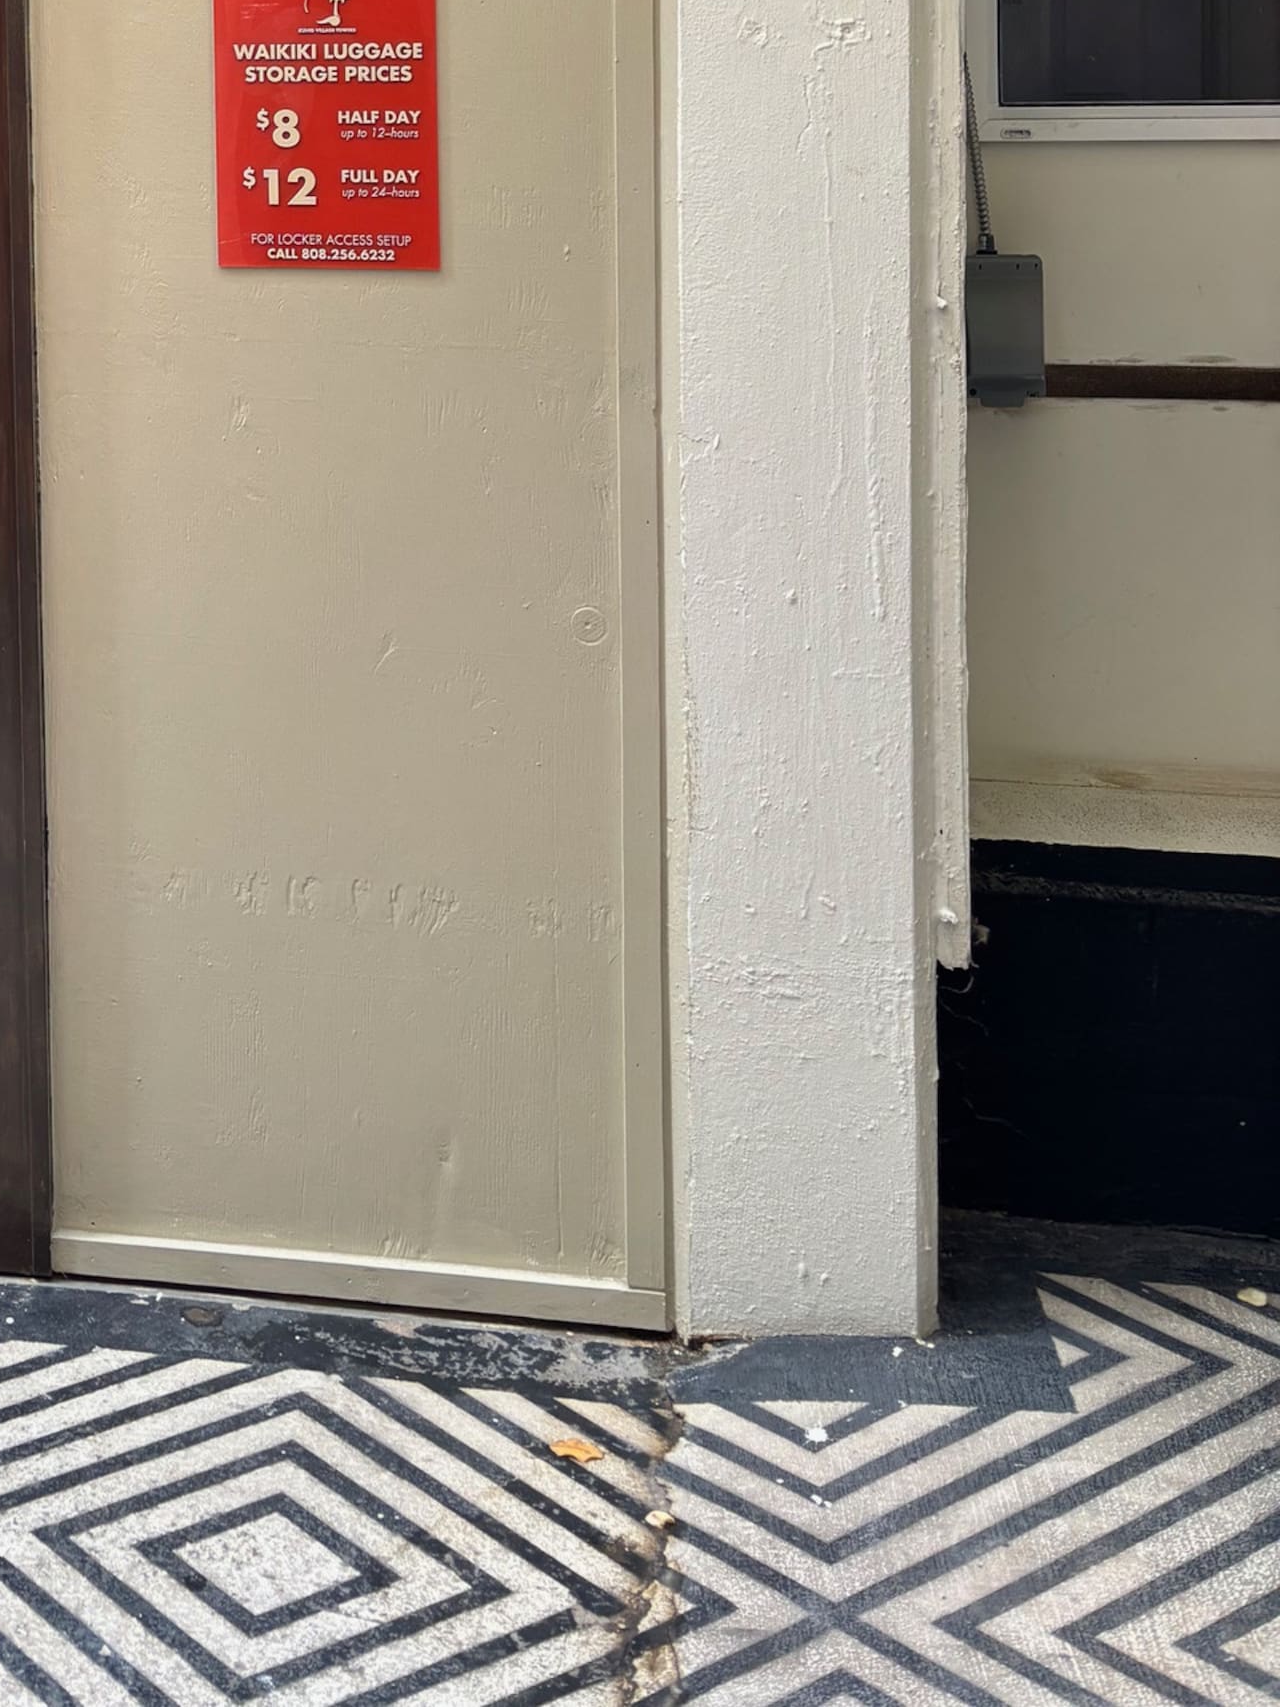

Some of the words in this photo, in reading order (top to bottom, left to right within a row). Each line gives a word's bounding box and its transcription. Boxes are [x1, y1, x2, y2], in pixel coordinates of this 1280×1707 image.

[233, 44, 317, 60] WAIKIKI
[324, 43, 423, 59] LUGGAGE
[245, 66, 338, 82] STORAGE
[345, 65, 412, 82] PRICES
[337, 110, 380, 124] HALF
[384, 110, 421, 124] DAY
[340, 129, 354, 141] up
[357, 128, 367, 138] to
[341, 169, 379, 184] FULL
[383, 169, 420, 184] DAY
[341, 188, 355, 199] up
[358, 188, 368, 198] to
[251, 233, 274, 245] FOR
[278, 233, 321, 246] LOCKER
[327, 234, 373, 246] ACCESS
[377, 235, 412, 247] SETUP
[267, 248, 298, 259] CALL
[302, 248, 396, 261] 808.256.6232
